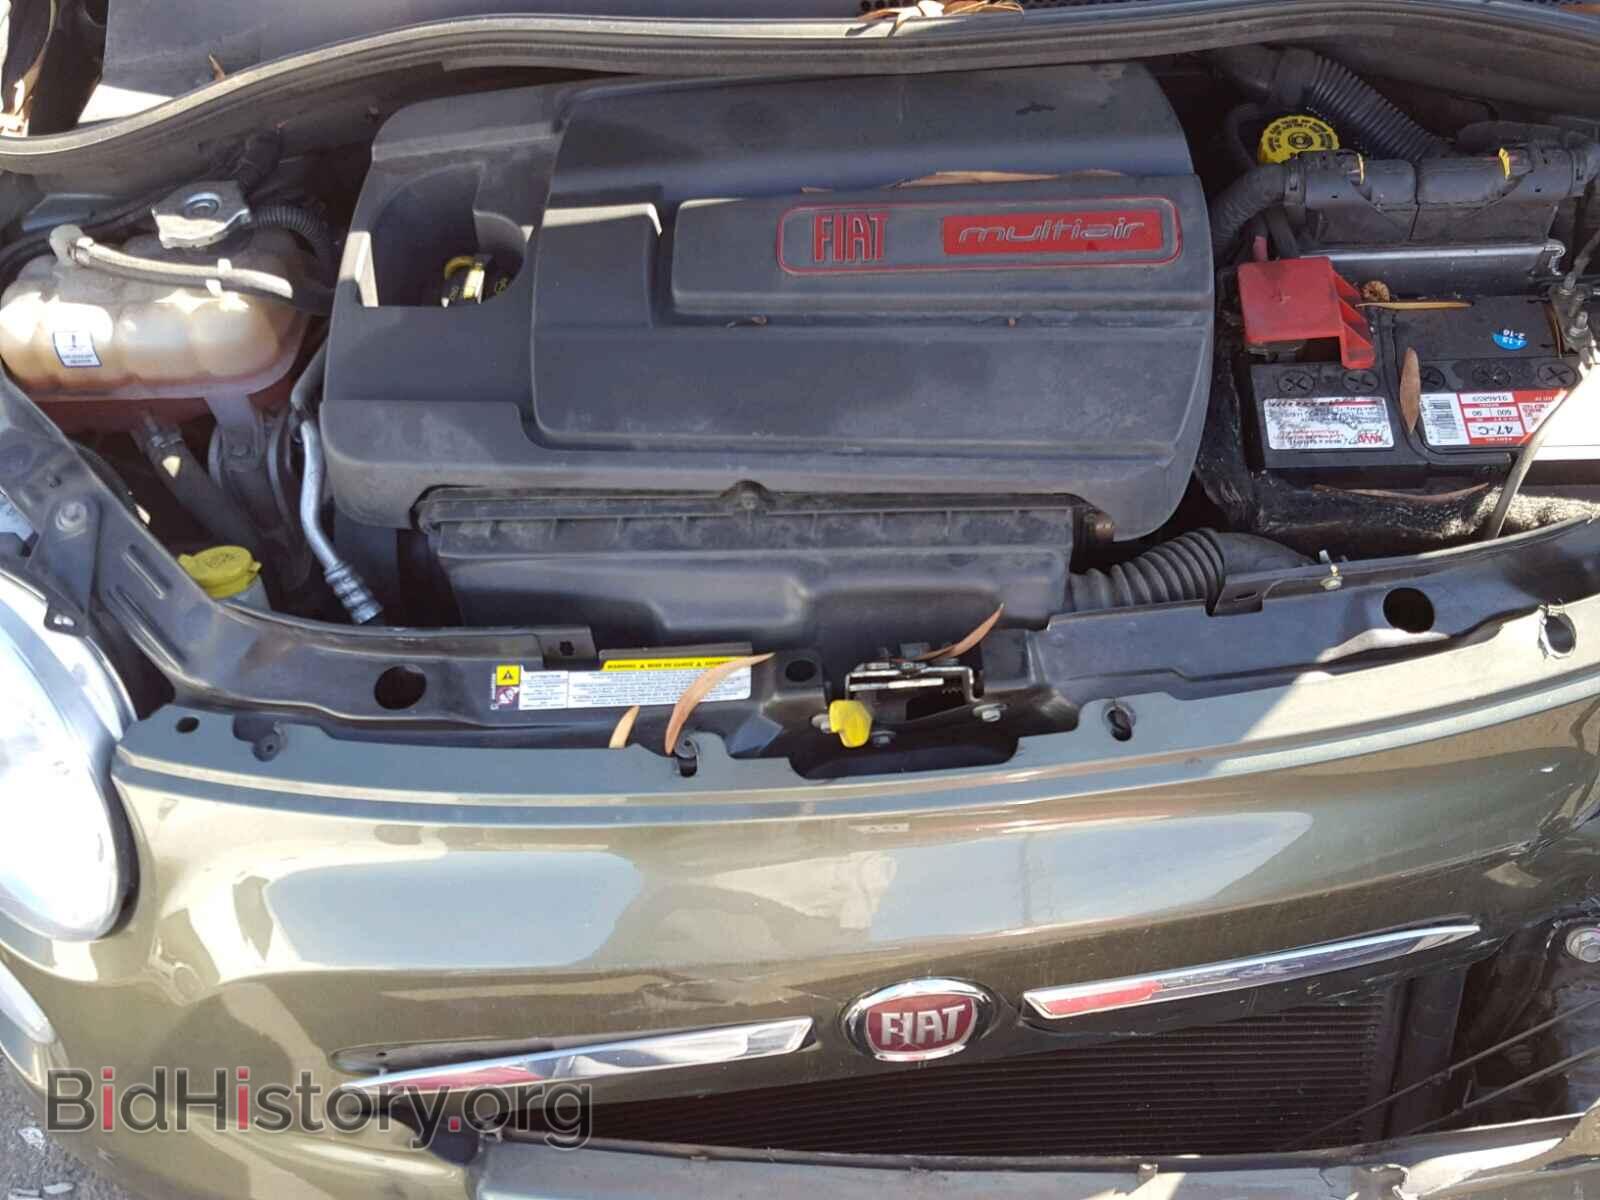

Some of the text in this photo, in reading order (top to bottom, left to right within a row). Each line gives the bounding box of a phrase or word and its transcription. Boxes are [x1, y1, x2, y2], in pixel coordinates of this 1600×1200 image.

[813, 212, 1145, 263] FIAT multiair
[1477, 425, 1514, 436] 47-C
[880, 1004, 967, 1046] FIAT
